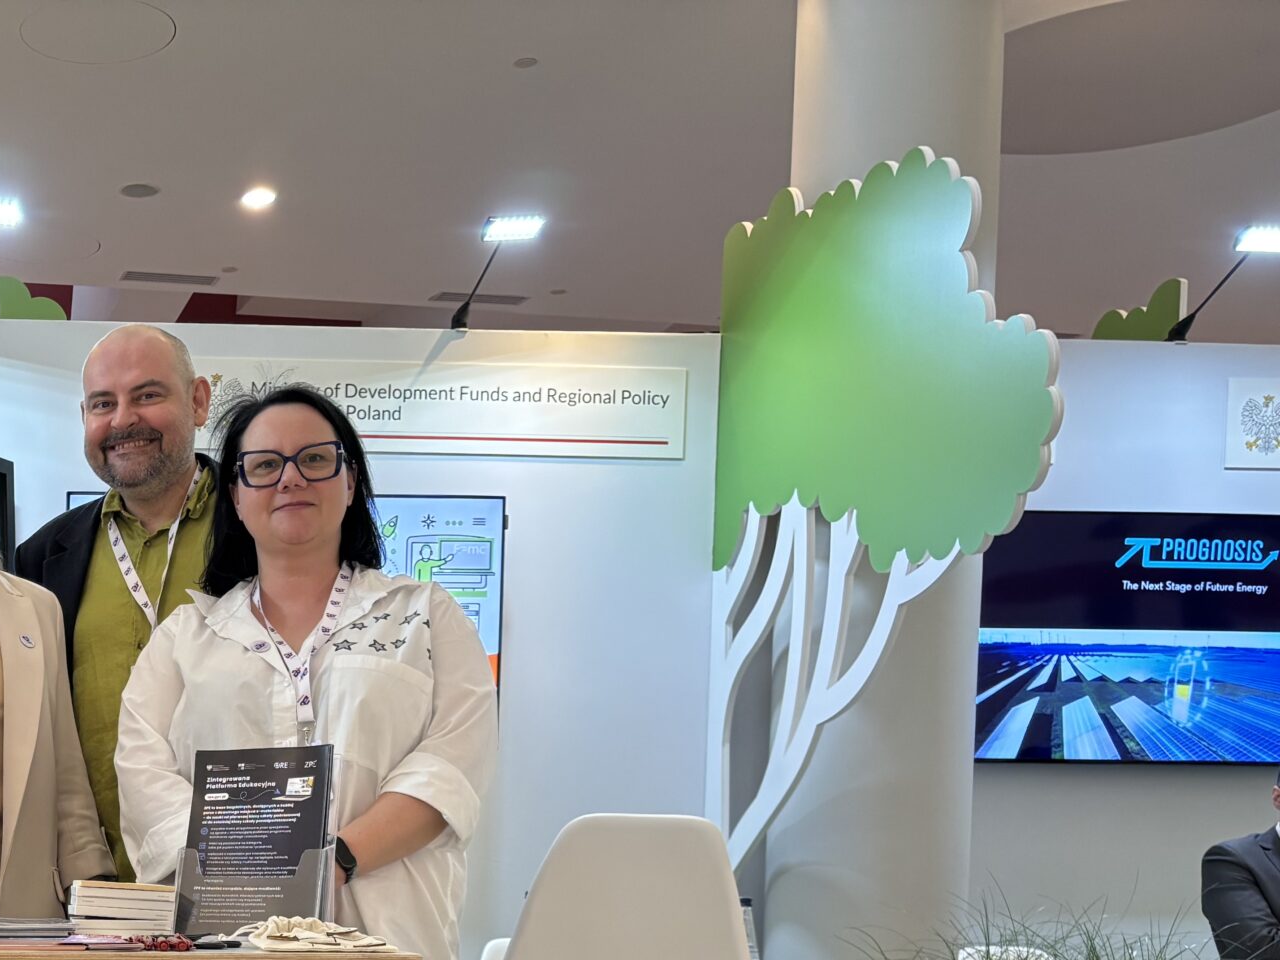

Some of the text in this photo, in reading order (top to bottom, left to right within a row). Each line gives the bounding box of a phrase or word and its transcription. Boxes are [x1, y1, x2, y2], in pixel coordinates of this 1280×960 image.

[324, 383, 341, 398] of
[345, 383, 455, 403] Development
[459, 386, 509, 402] Funds
[513, 387, 542, 403] and
[547, 387, 616, 407] Regional
[621, 389, 671, 408] Policy
[346, 405, 402, 421] Poland
[1162, 538, 1264, 562] PROGNOSIS
[1122, 580, 1269, 595] The Next Stage of Future Energy
[205, 780, 276, 790] Platforma Edukacyjna
[206, 775, 251, 784] Zintegrowana
